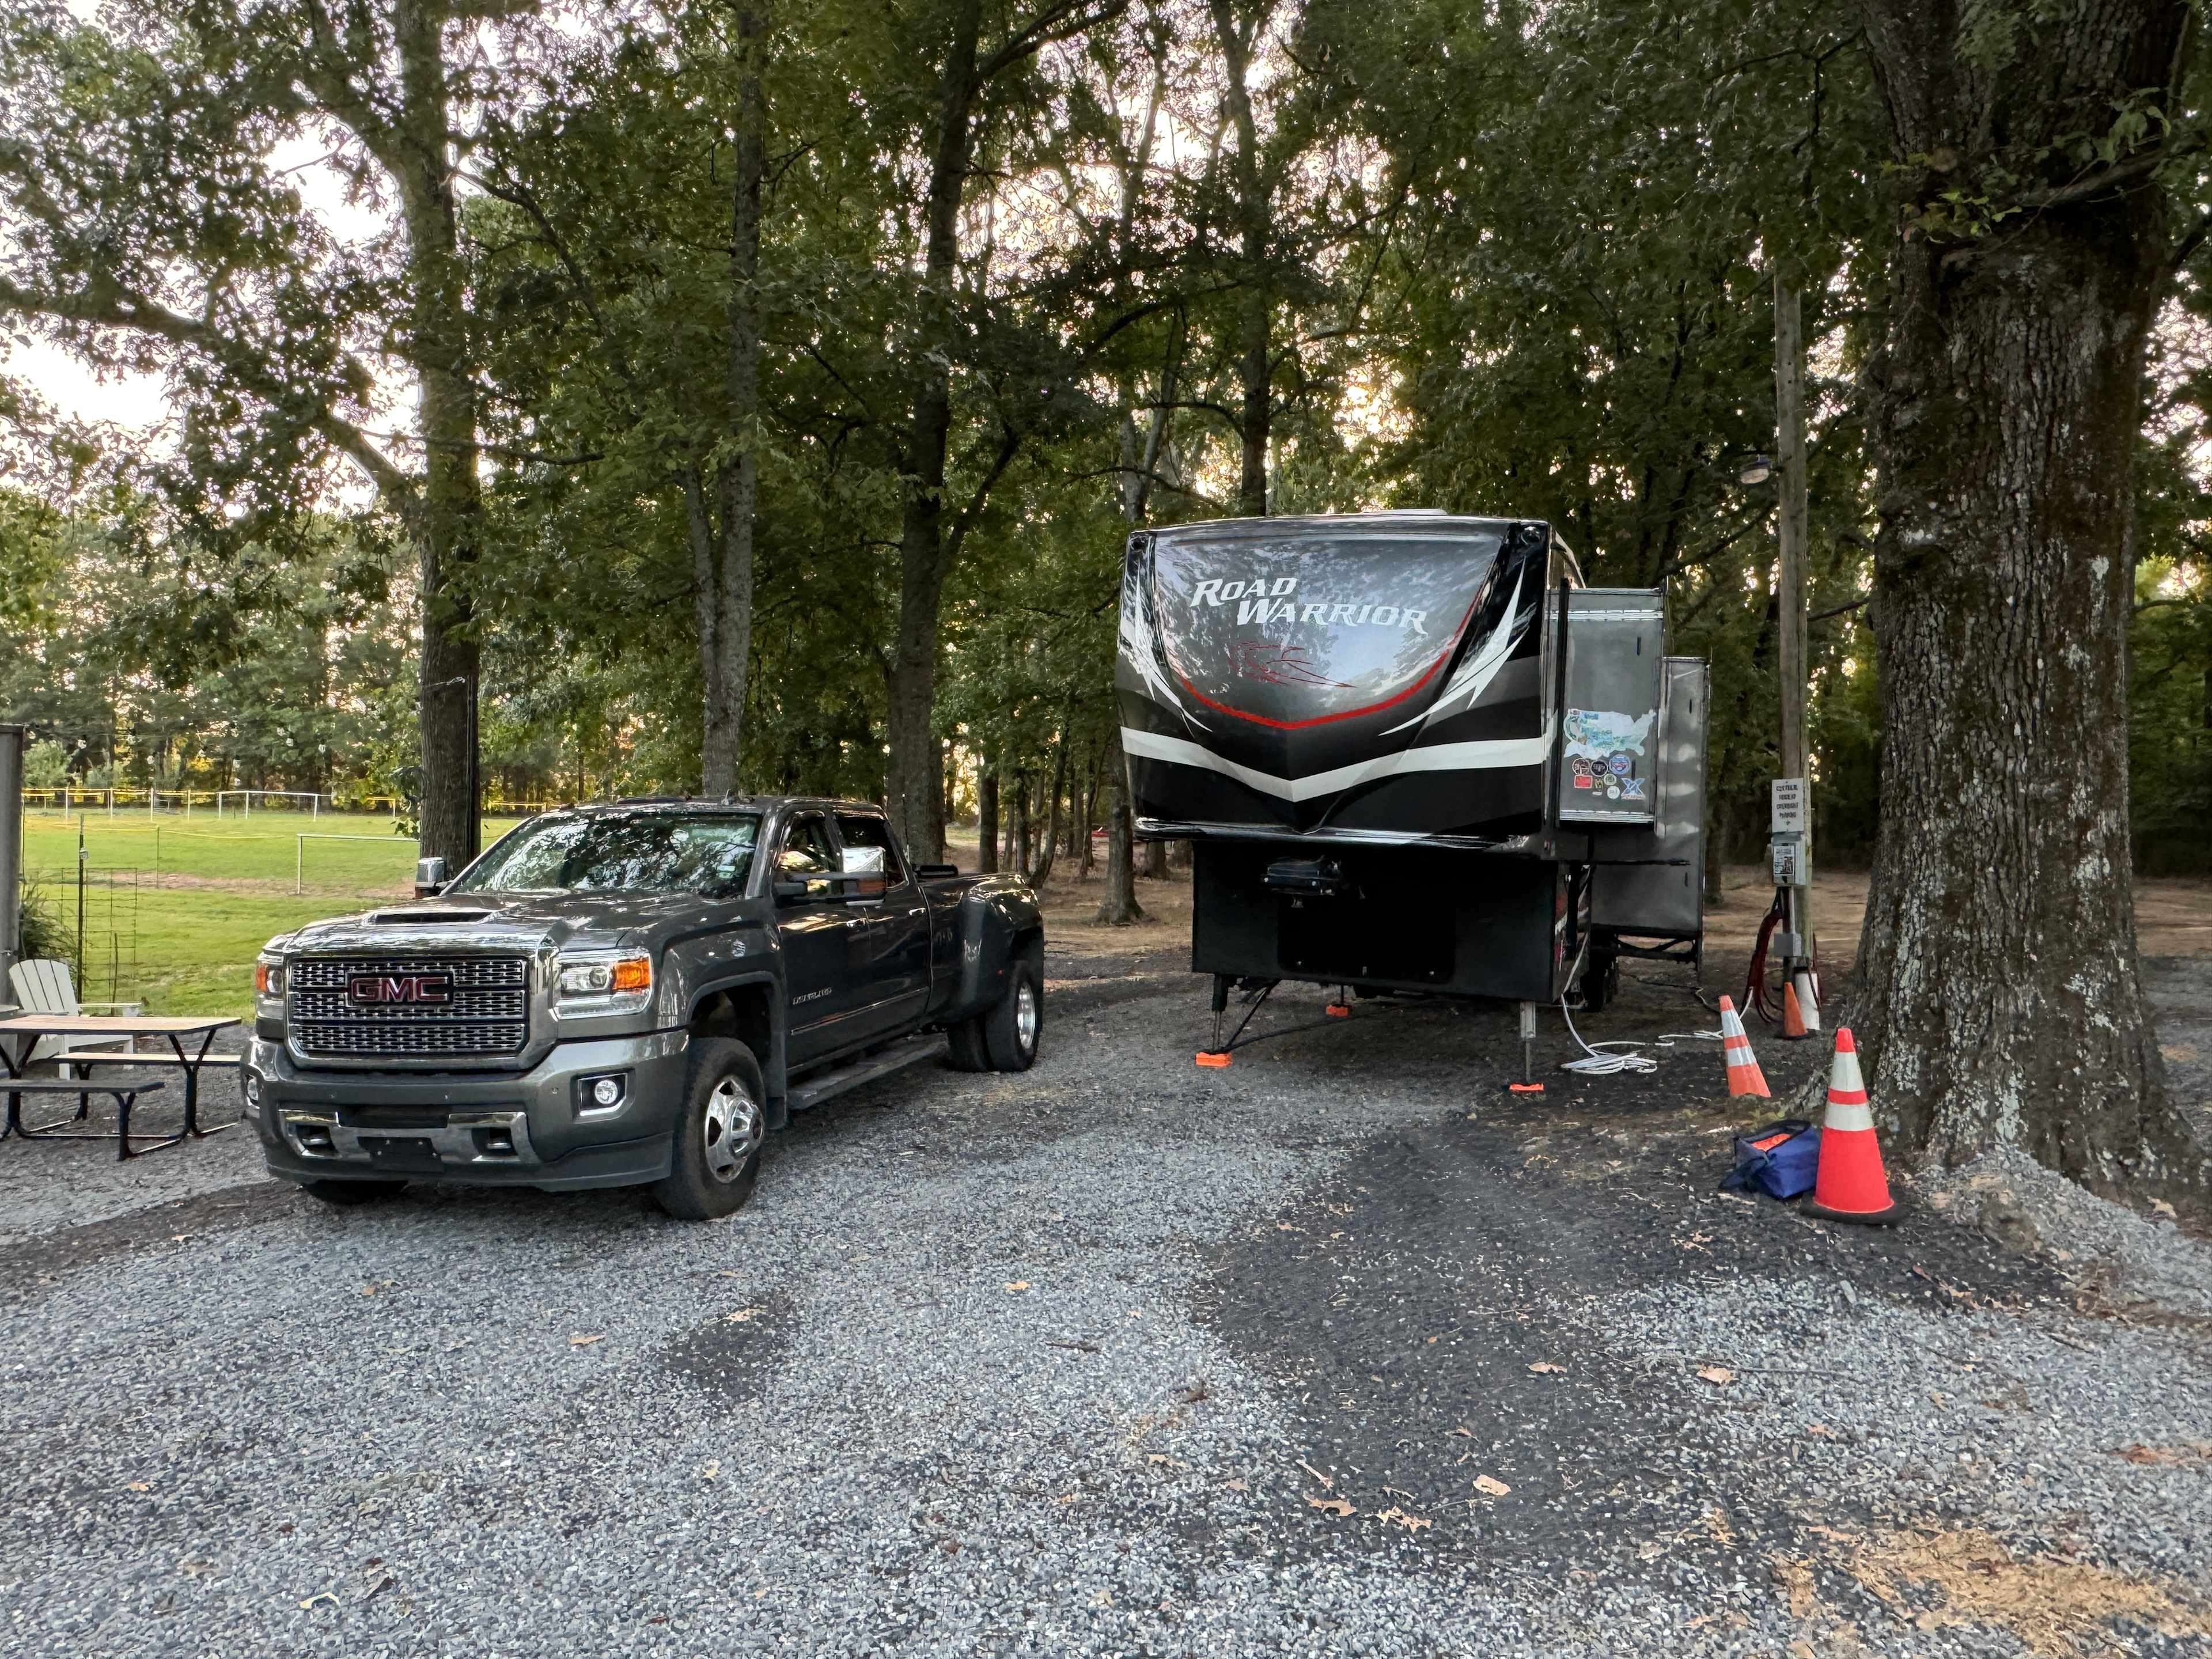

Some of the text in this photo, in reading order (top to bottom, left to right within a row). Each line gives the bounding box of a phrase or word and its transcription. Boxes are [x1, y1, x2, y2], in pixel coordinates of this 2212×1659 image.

[1190, 577, 1299, 608] ROAD
[1236, 597, 1429, 636] WARRIOR
[351, 977, 448, 1002] GMC
